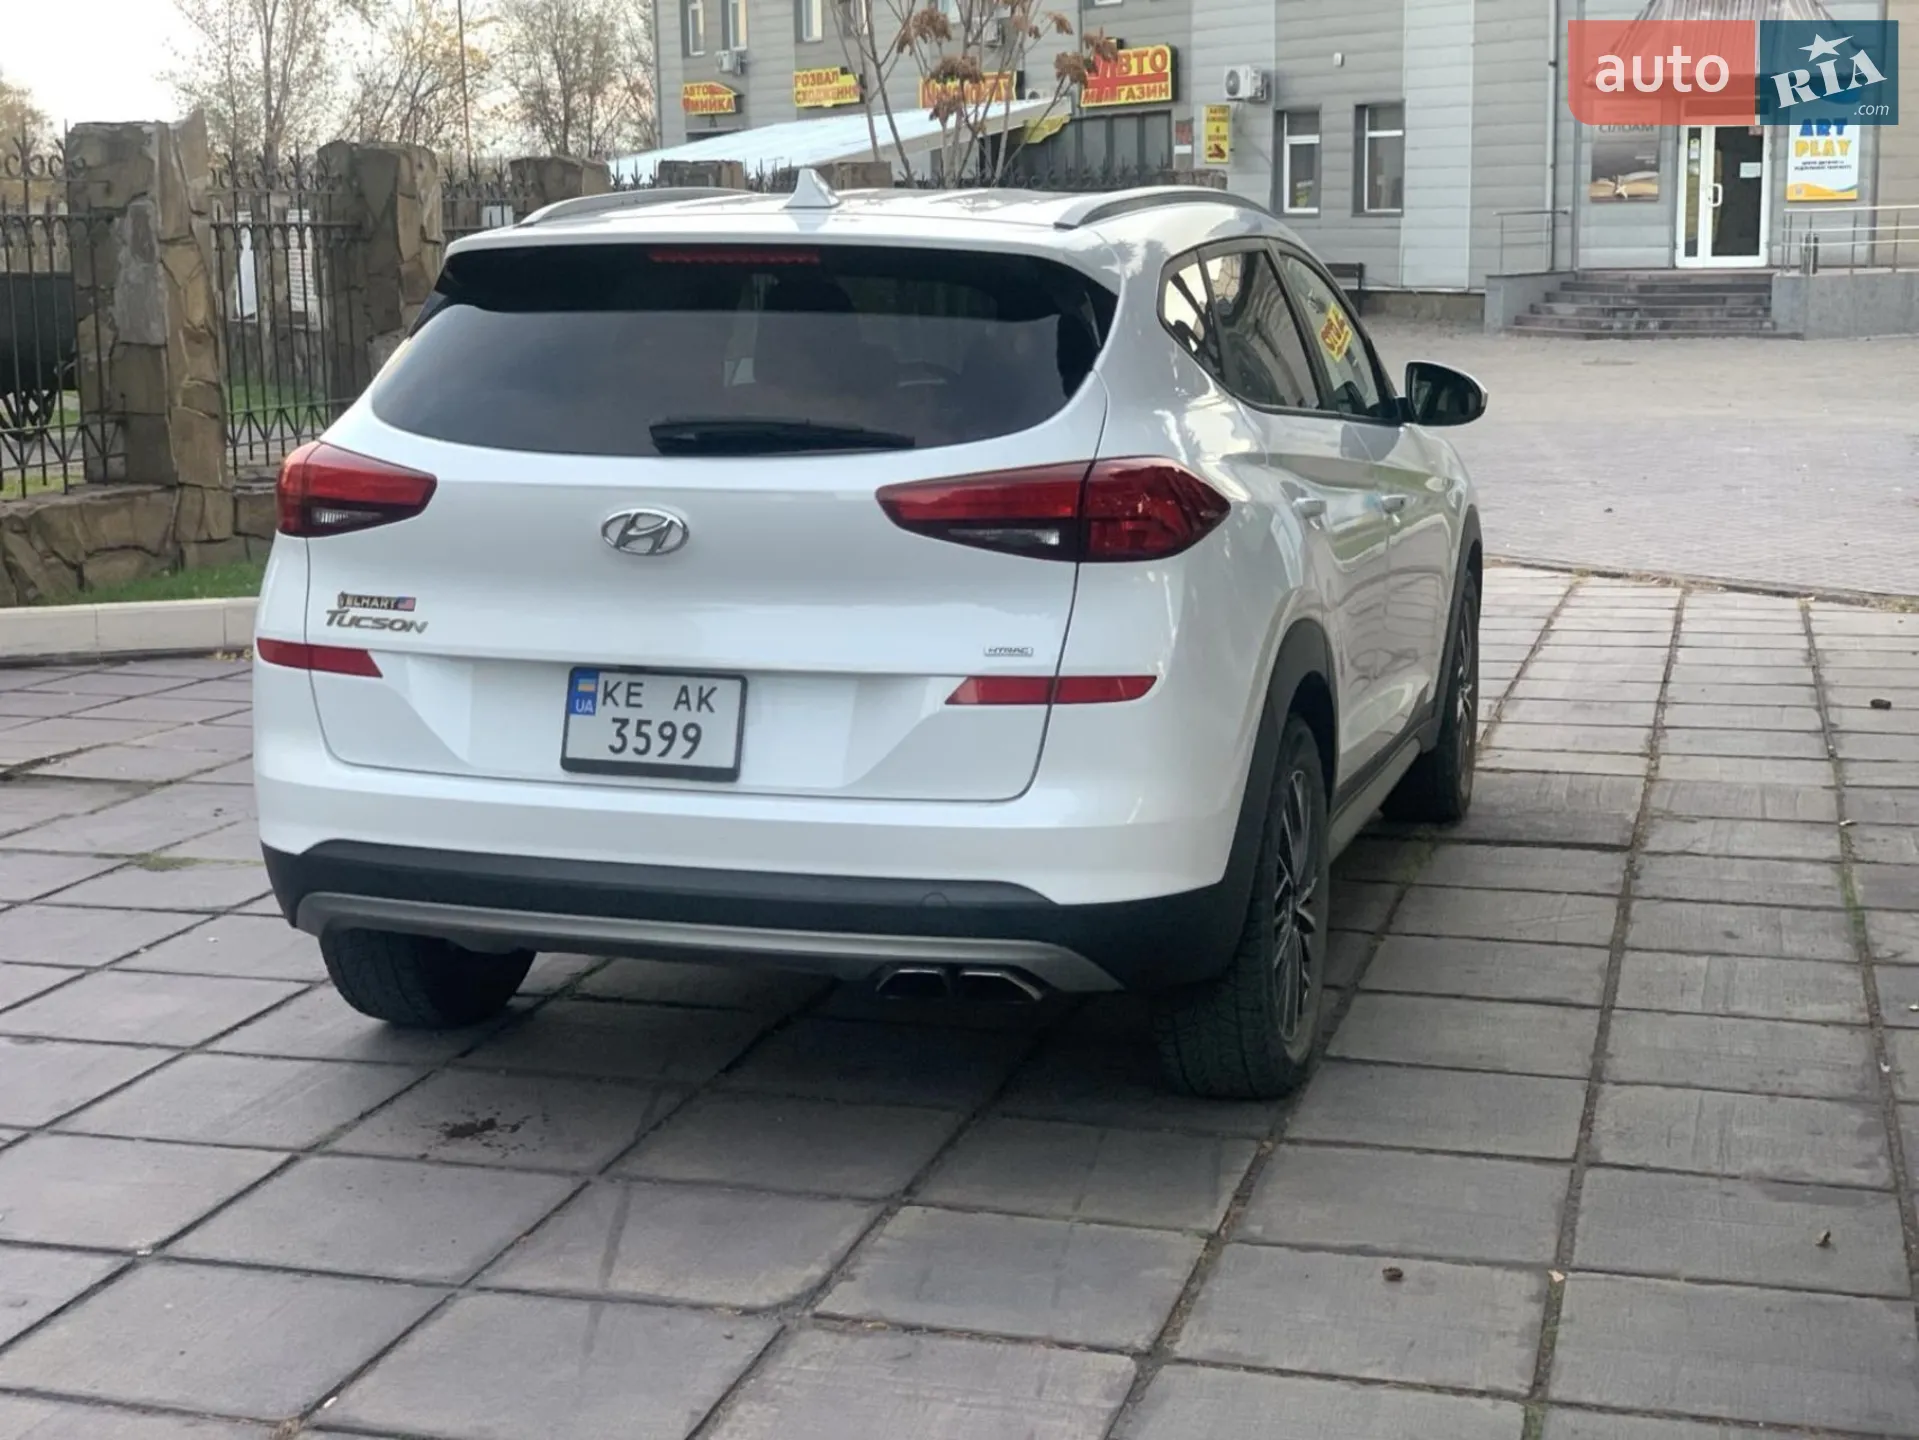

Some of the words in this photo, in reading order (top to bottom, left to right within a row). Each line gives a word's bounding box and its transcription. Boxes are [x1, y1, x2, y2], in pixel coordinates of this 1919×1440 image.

[1795, 139, 1852, 157] PLAY
[575, 698, 593, 713] UA
[608, 716, 702, 760] 3599
